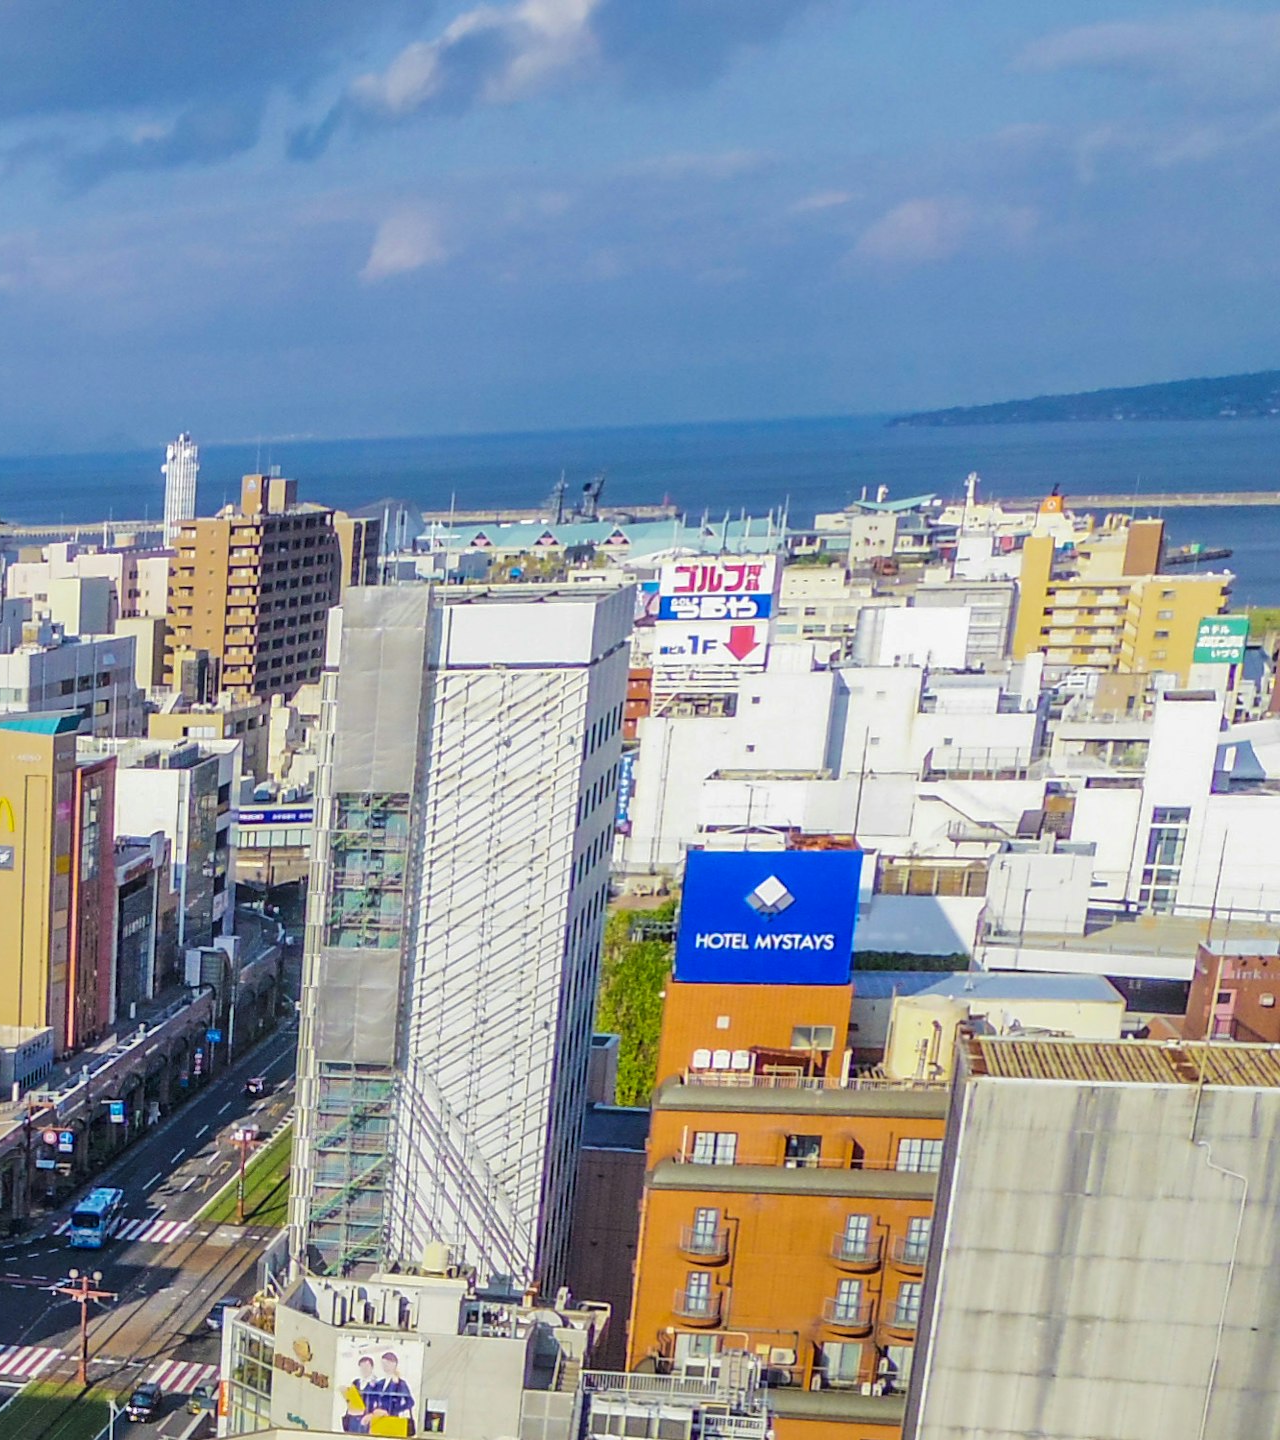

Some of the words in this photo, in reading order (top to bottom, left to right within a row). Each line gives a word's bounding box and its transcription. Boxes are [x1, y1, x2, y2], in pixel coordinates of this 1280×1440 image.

[688, 635, 718, 655] 1F
[695, 932, 749, 950] HOTEL
[754, 933, 835, 951] MYSTAYS
